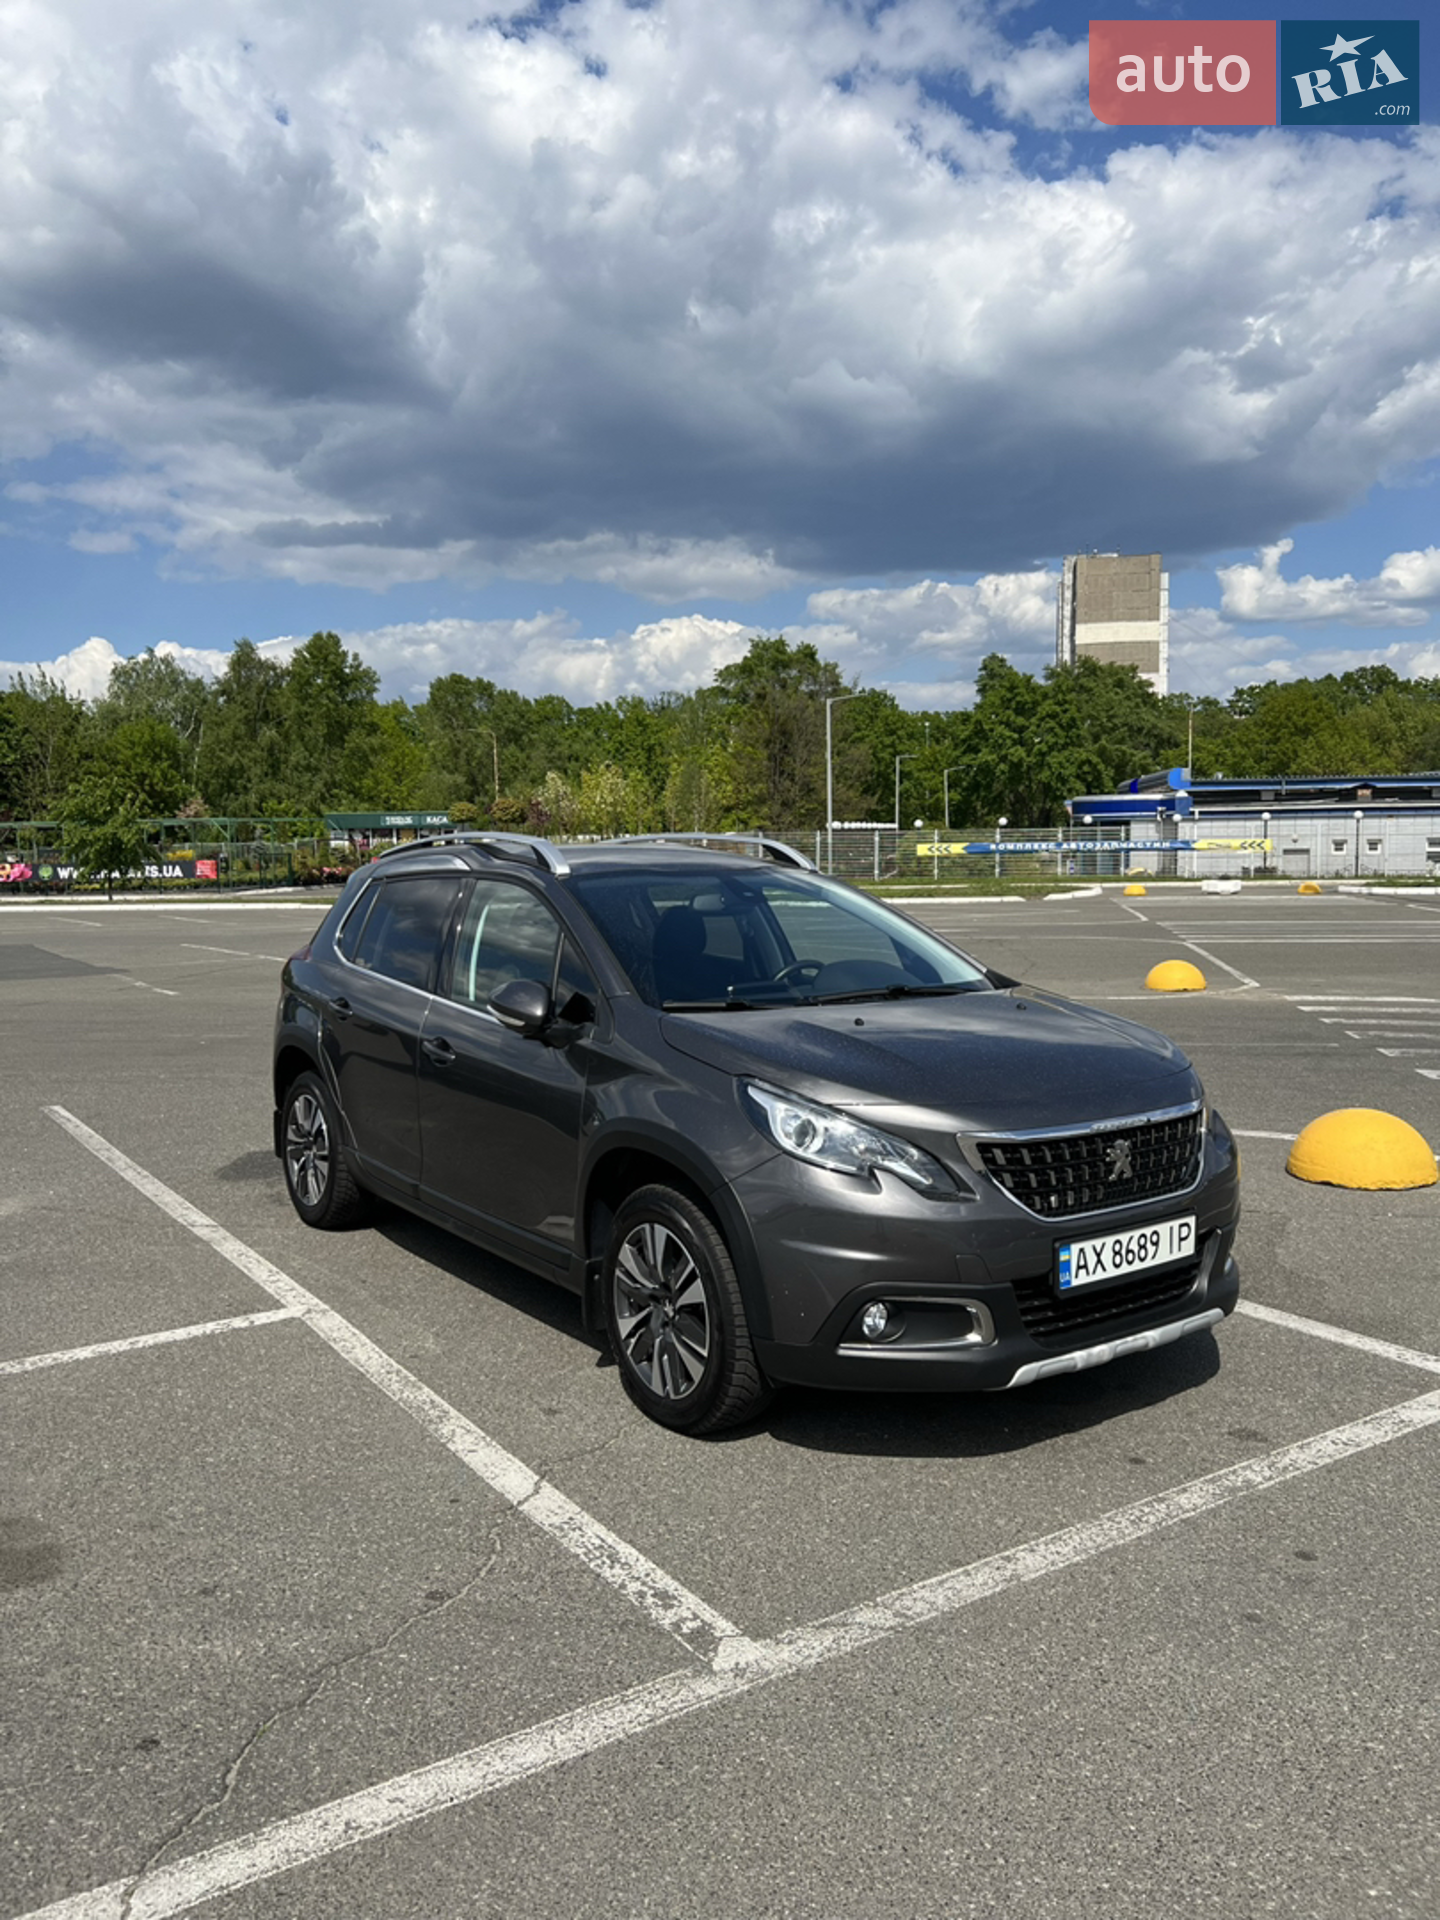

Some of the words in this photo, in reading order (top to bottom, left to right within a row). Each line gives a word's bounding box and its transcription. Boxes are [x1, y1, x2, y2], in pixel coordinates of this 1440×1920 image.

[1075, 1242, 1107, 1279] AX
[1112, 1230, 1160, 1269] 8689
[1169, 1222, 1192, 1254] IP
[1059, 1270, 1071, 1283] UA
